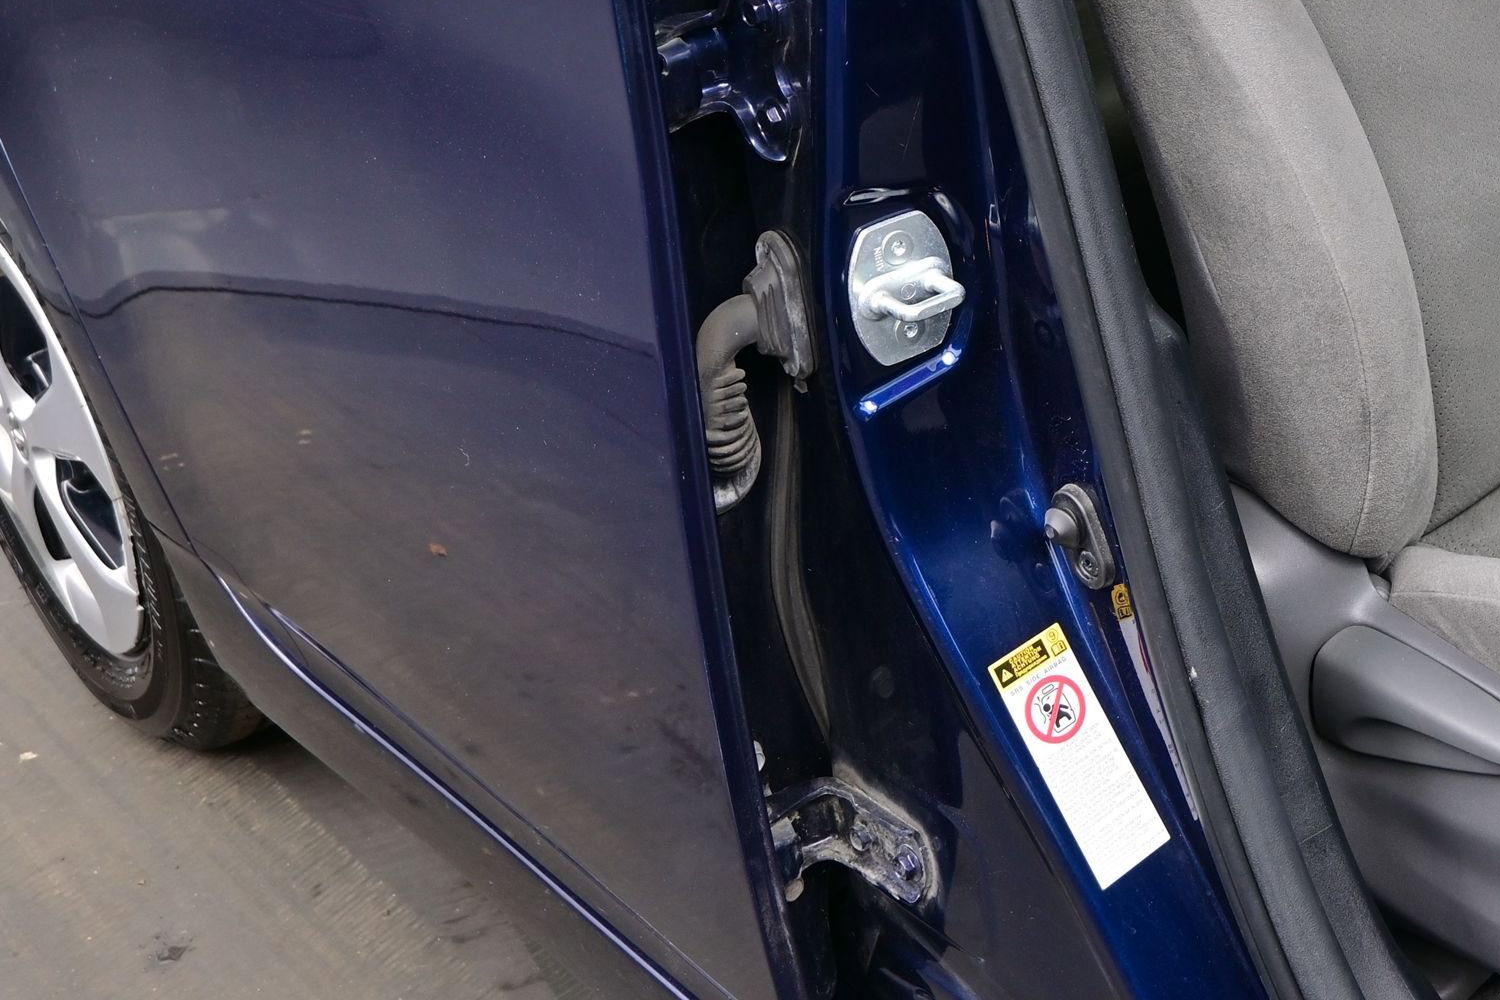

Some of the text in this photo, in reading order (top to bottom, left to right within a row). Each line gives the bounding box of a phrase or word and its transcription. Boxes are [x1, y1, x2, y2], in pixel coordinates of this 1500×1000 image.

[1008, 645, 1034, 664] CAUTION
[1011, 646, 1042, 669] ATTENTION
[1013, 652, 1041, 674] ACHTUNG
[1044, 656, 1067, 675] AIRBAG
